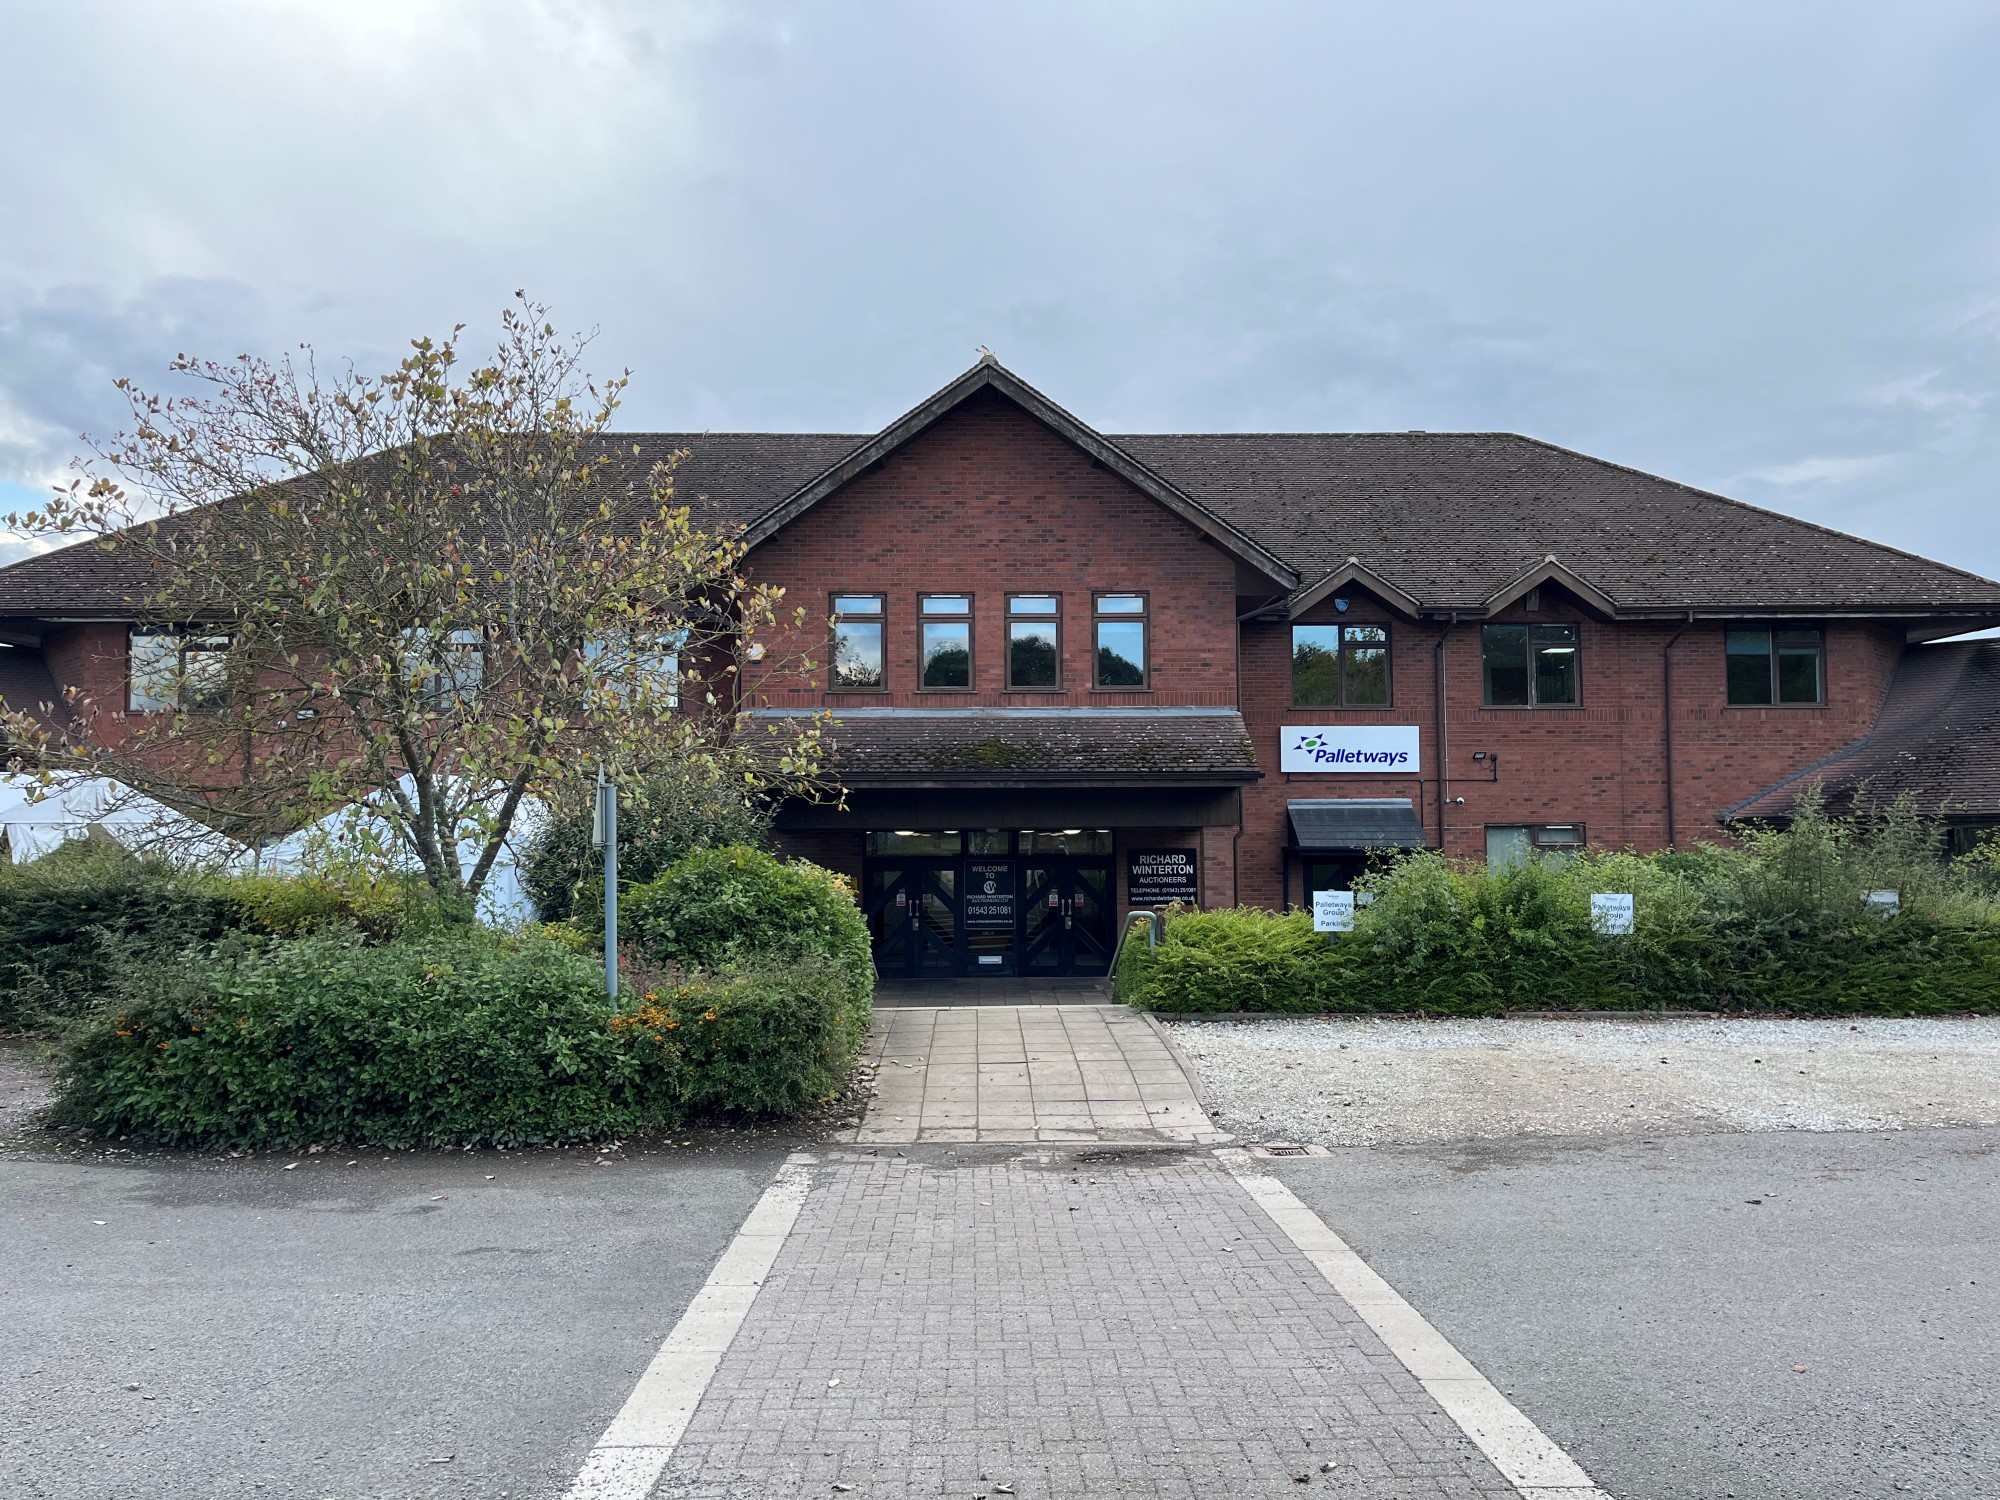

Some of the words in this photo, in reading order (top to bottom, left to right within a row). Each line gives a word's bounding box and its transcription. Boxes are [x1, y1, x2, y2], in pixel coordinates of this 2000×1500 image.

[1315, 748, 1408, 766] Palletways
[1140, 854, 1186, 864] RICHARD
[1132, 864, 1194, 874] WINTERTON
[968, 906, 988, 914] 01543
